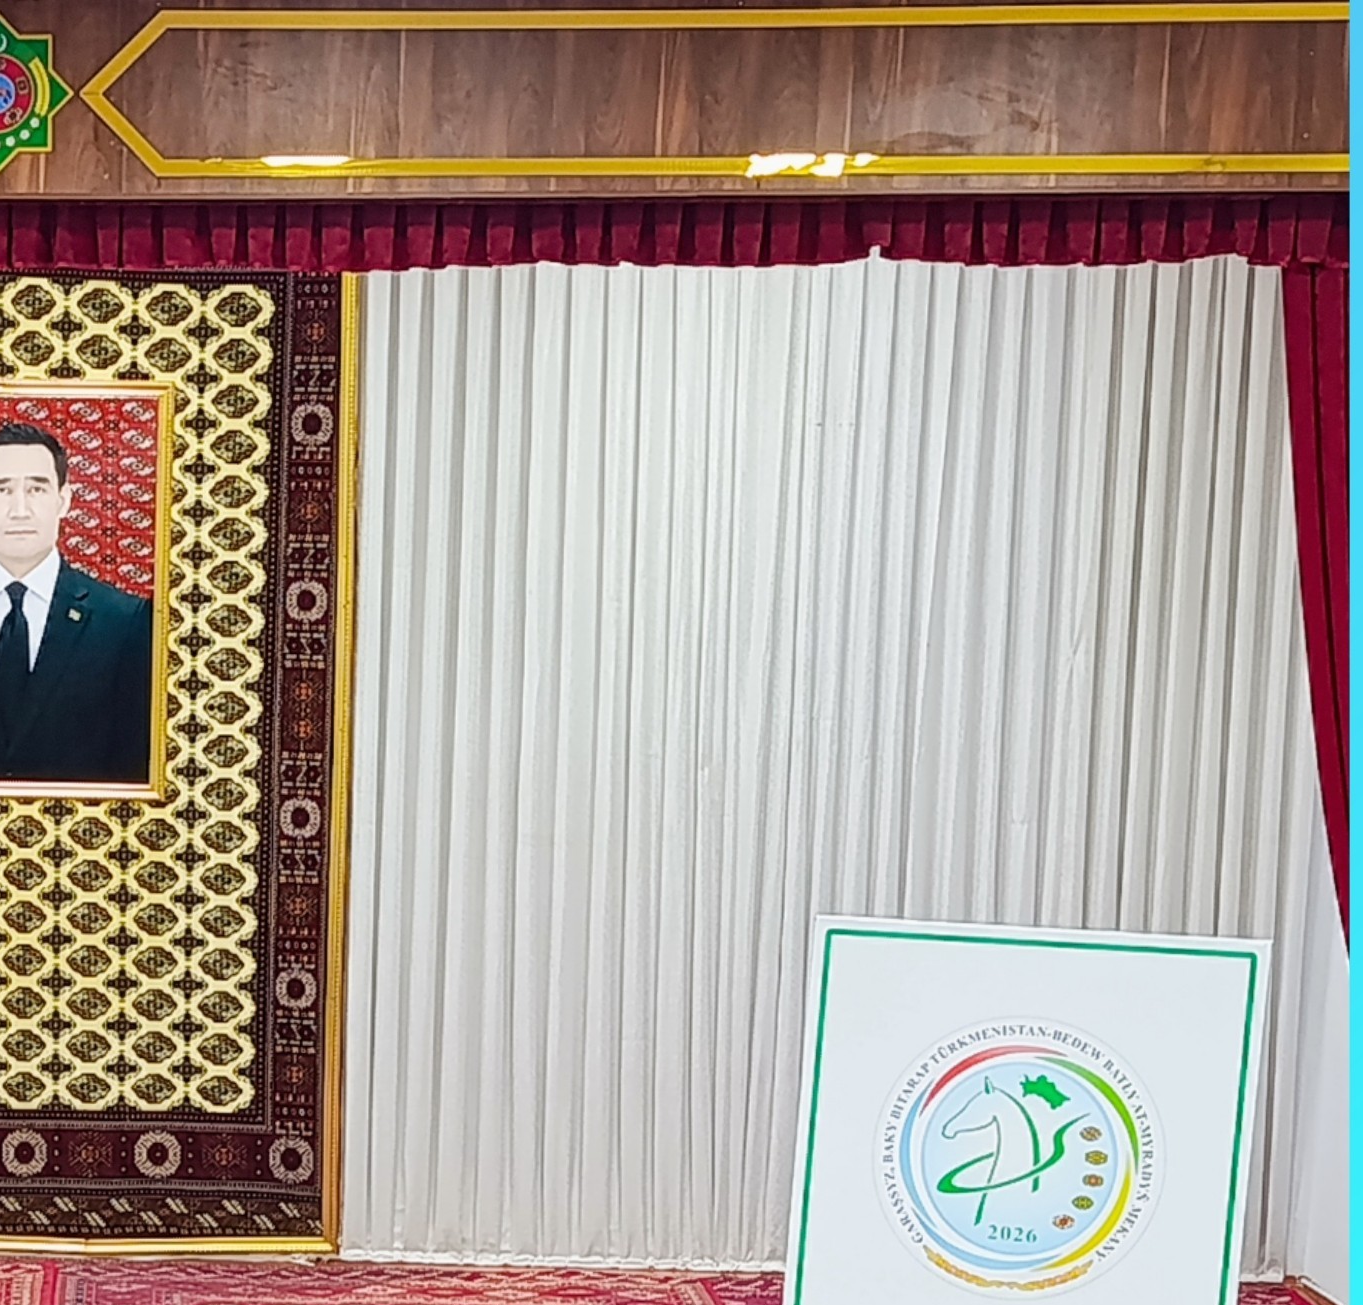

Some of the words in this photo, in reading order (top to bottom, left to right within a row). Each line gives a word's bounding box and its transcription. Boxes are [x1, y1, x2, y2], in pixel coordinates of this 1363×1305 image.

[890, 1062, 930, 1121] BITARAP
[1103, 1059, 1140, 1106] BATLY
[883, 1121, 897, 1163] BAKY
[987, 1224, 1037, 1244] 2026
[1095, 1204, 1142, 1262] MEKANY
